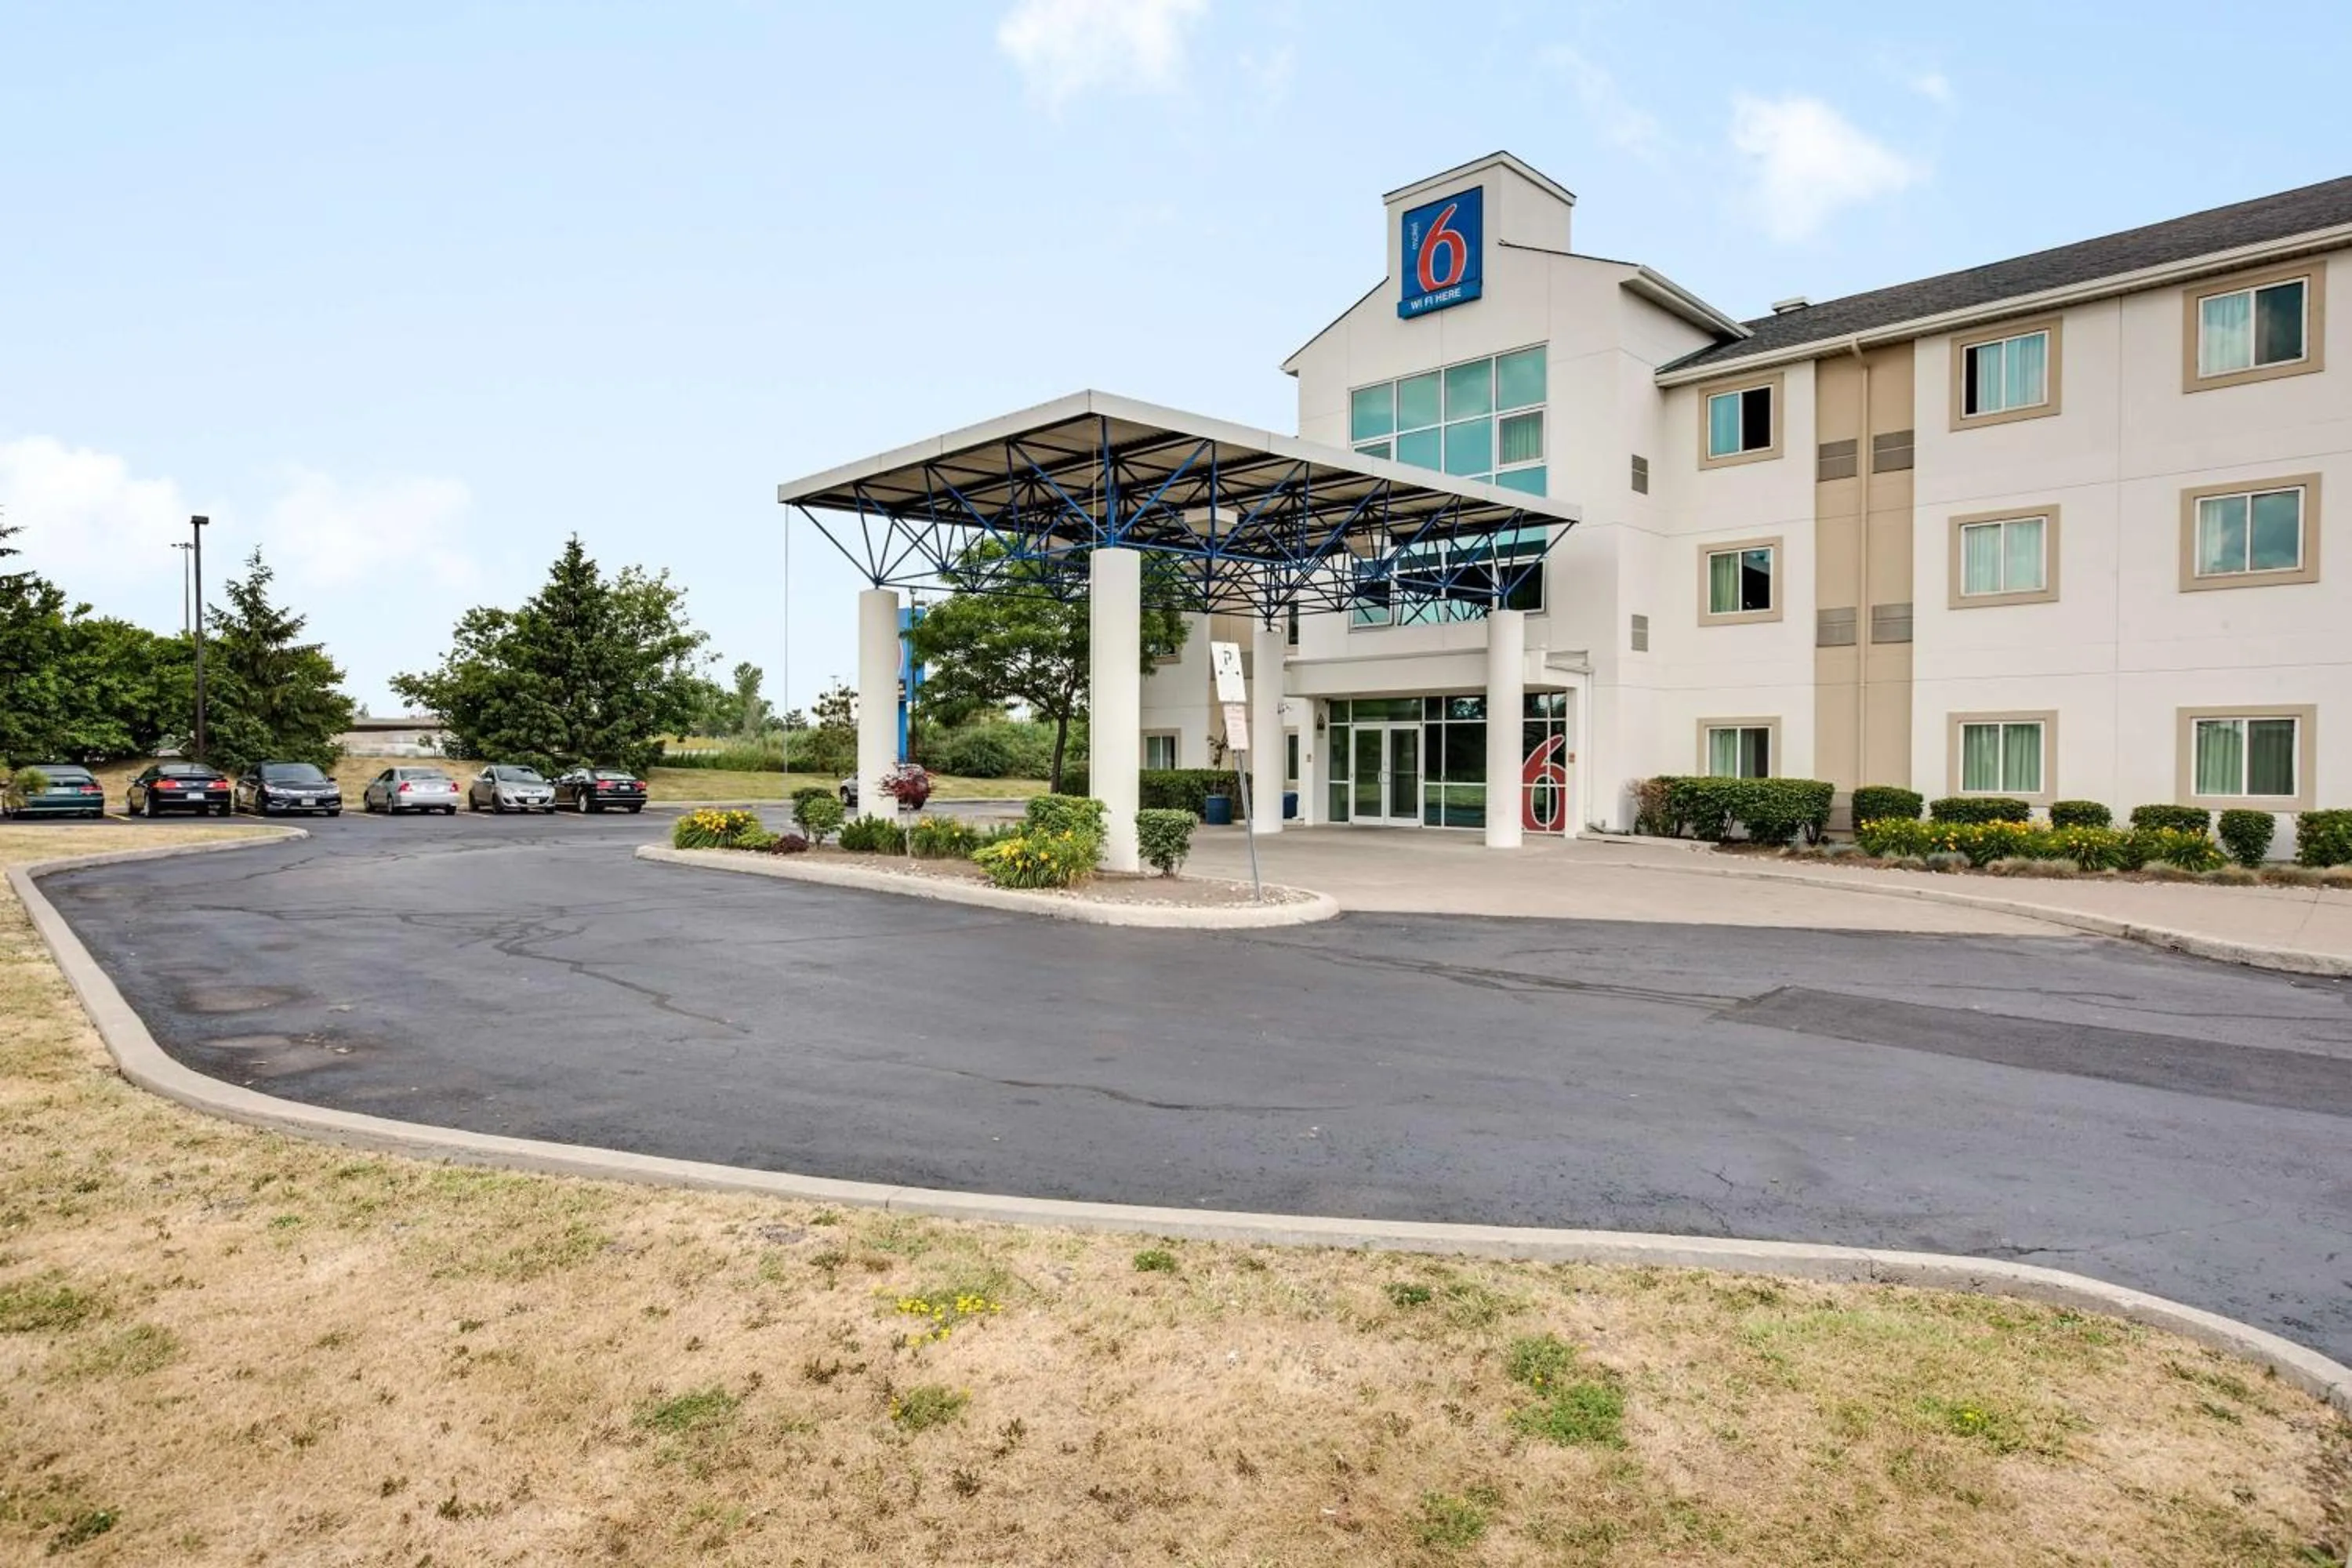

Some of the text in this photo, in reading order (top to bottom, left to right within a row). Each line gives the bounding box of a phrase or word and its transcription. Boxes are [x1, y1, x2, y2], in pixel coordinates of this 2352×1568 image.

[1418, 203, 1467, 292] 6
[1436, 288, 1461, 303] HERE
[1523, 734, 1566, 833] 6
